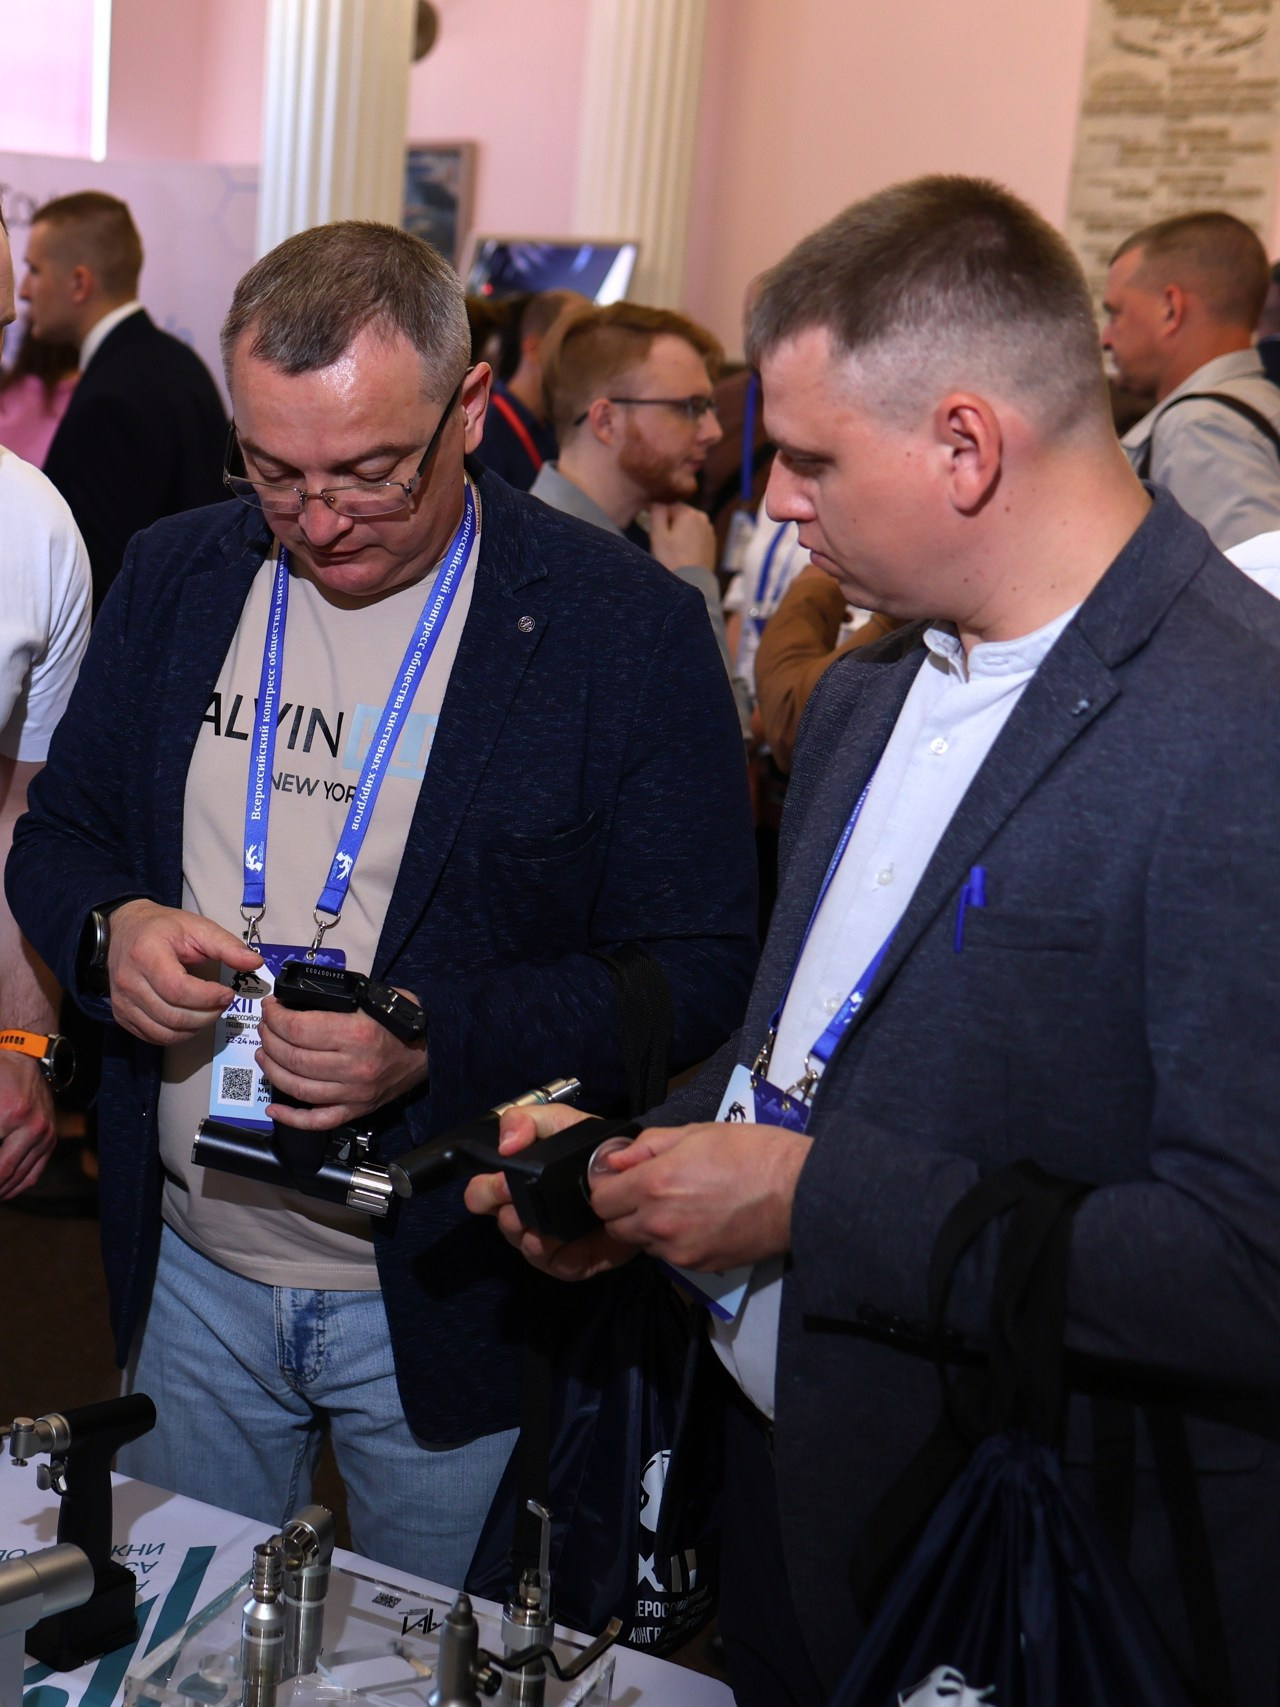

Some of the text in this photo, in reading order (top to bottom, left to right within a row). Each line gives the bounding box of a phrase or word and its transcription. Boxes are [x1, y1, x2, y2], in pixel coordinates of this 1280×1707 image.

[268, 607, 281, 666] общества
[351, 503, 473, 831] Всероссийский конгресс общества кистевых хирургов
[263, 669, 276, 722] конгресс
[251, 726, 269, 820] Всероссийский
[271, 772, 356, 804] NEW YOR
[226, 1013, 263, 1022] ВСЕРОССИЙСКИ
[227, 998, 253, 1013] XII
[225, 1036, 247, 1045] 22-24
